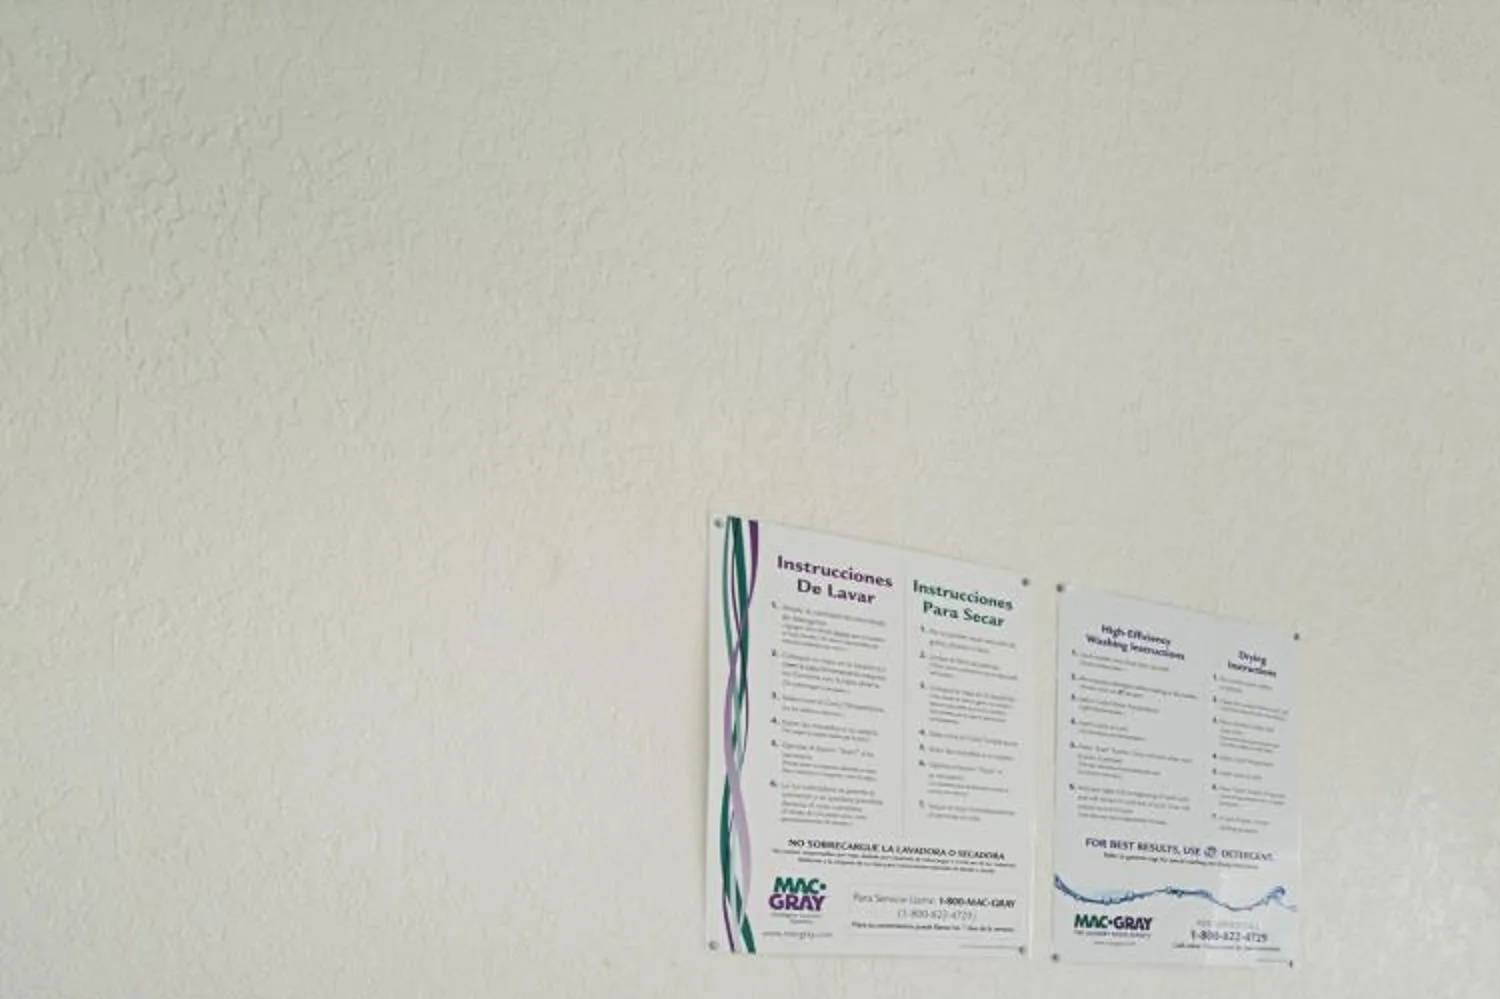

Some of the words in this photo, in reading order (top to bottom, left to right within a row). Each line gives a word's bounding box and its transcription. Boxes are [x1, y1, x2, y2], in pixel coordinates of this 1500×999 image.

[777, 554, 893, 588] Instrucciones
[797, 578, 822, 595] De
[827, 583, 876, 604] Lavar
[912, 579, 1013, 611] Instrucciones
[923, 600, 958, 619] Para
[963, 608, 1004, 627] Secar
[1086, 634, 1128, 652] Washing
[1130, 643, 1185, 661] Instructions
[1227, 661, 1277, 678] Instructions
[787, 838, 805, 847] NO
[807, 839, 880, 852] SOBRECARGUE
[881, 844, 894, 853] LA
[897, 845, 946, 857] LAVADORA
[958, 850, 1005, 860] SECADORA
[1085, 837, 1107, 849] FOR
[1110, 839, 1134, 851] BEST
[1183, 846, 1201, 856] USE
[768, 893, 826, 912] GRAY
